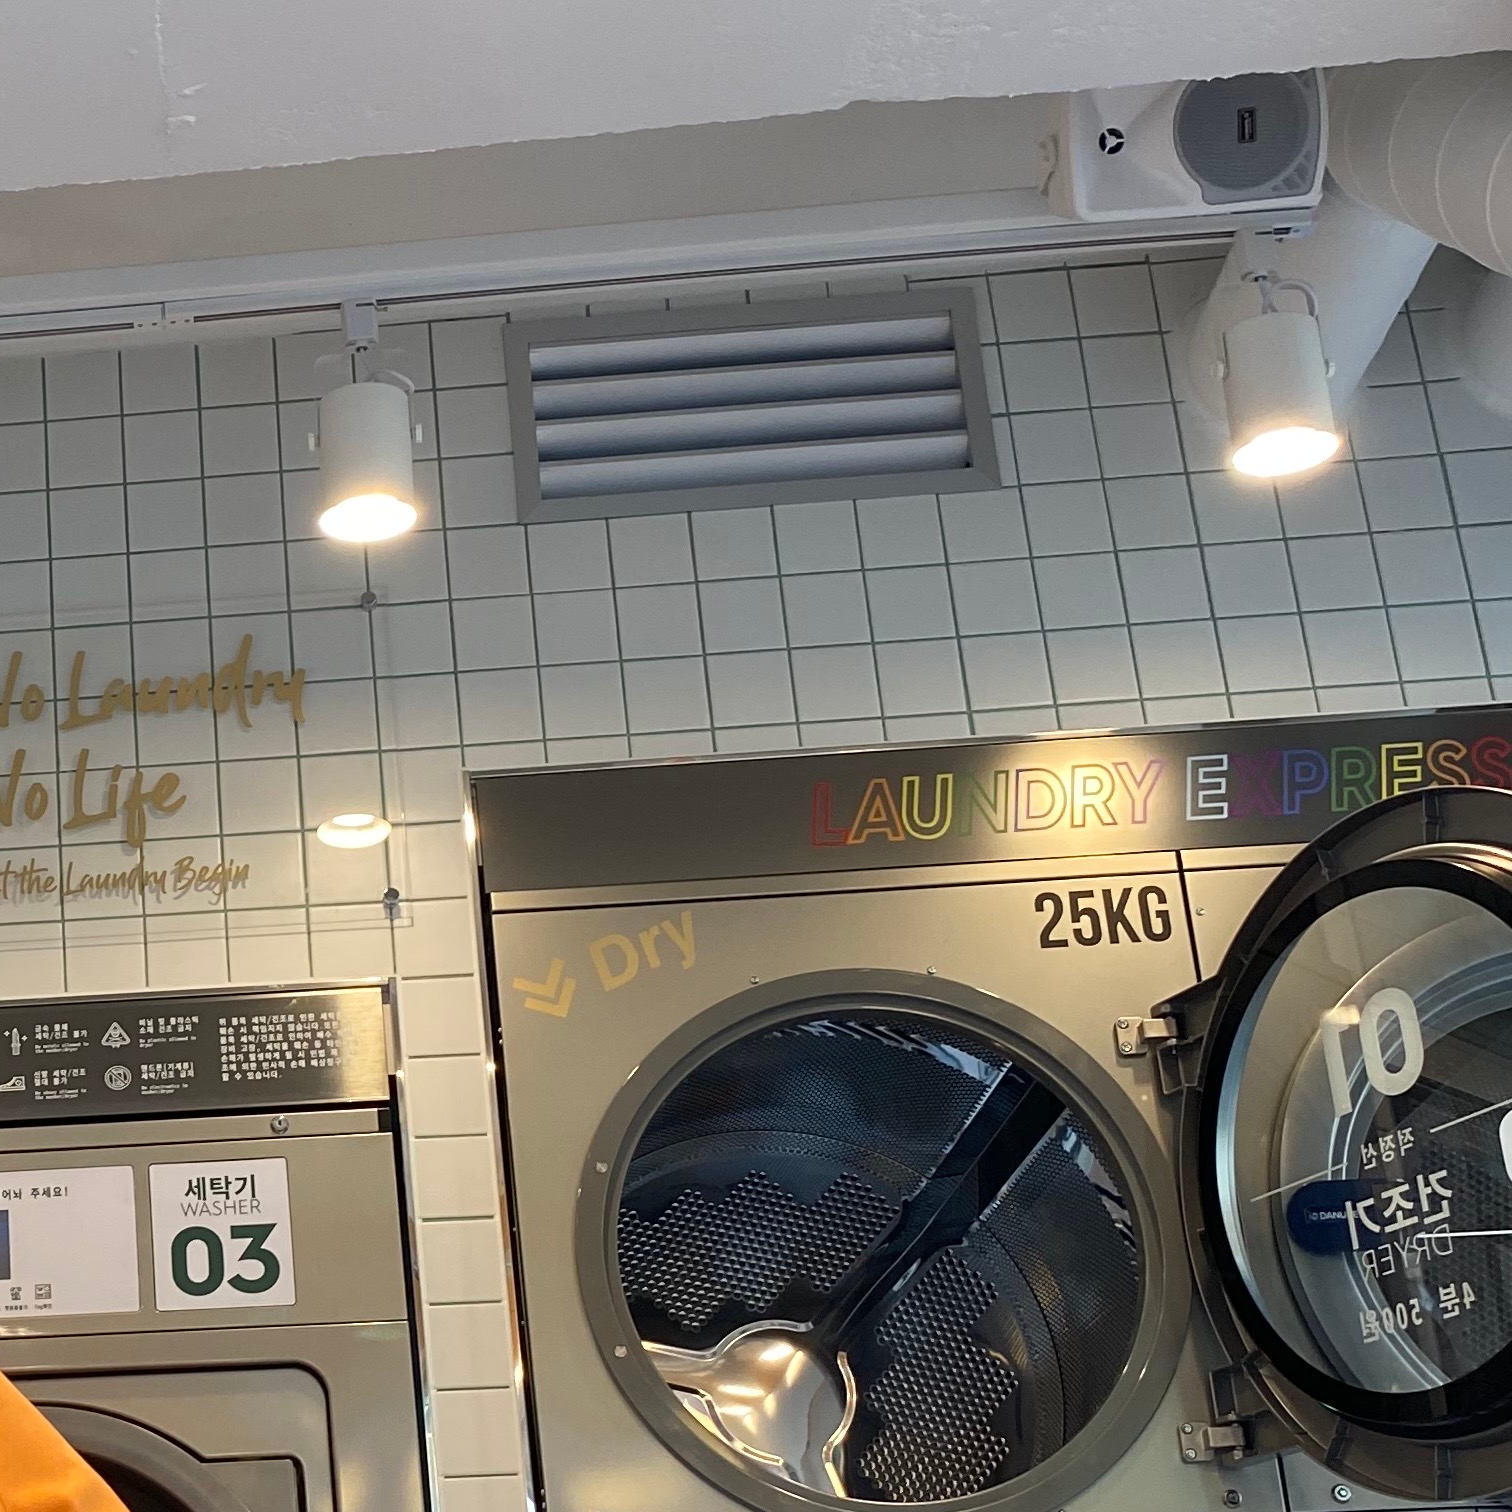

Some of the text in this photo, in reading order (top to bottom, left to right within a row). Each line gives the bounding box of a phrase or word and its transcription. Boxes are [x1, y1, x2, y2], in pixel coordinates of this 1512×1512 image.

[59, 633, 306, 730] Laundry
[63, 748, 186, 848] Life
[812, 736, 1512, 847] LAUNDRY EXPRESS
[17, 857, 56, 894] the
[63, 856, 167, 896] Laundry
[174, 856, 249, 896] Begin
[1035, 885, 1173, 949] 25KG
[589, 909, 696, 993] Dry
[30, 1186, 68, 1199] 주세요!
[180, 1199, 261, 1218] WASHER
[184, 1174, 256, 1201] 세탁기
[1320, 1210, 1360, 1220] DANUE
[170, 1222, 281, 1297] 03
